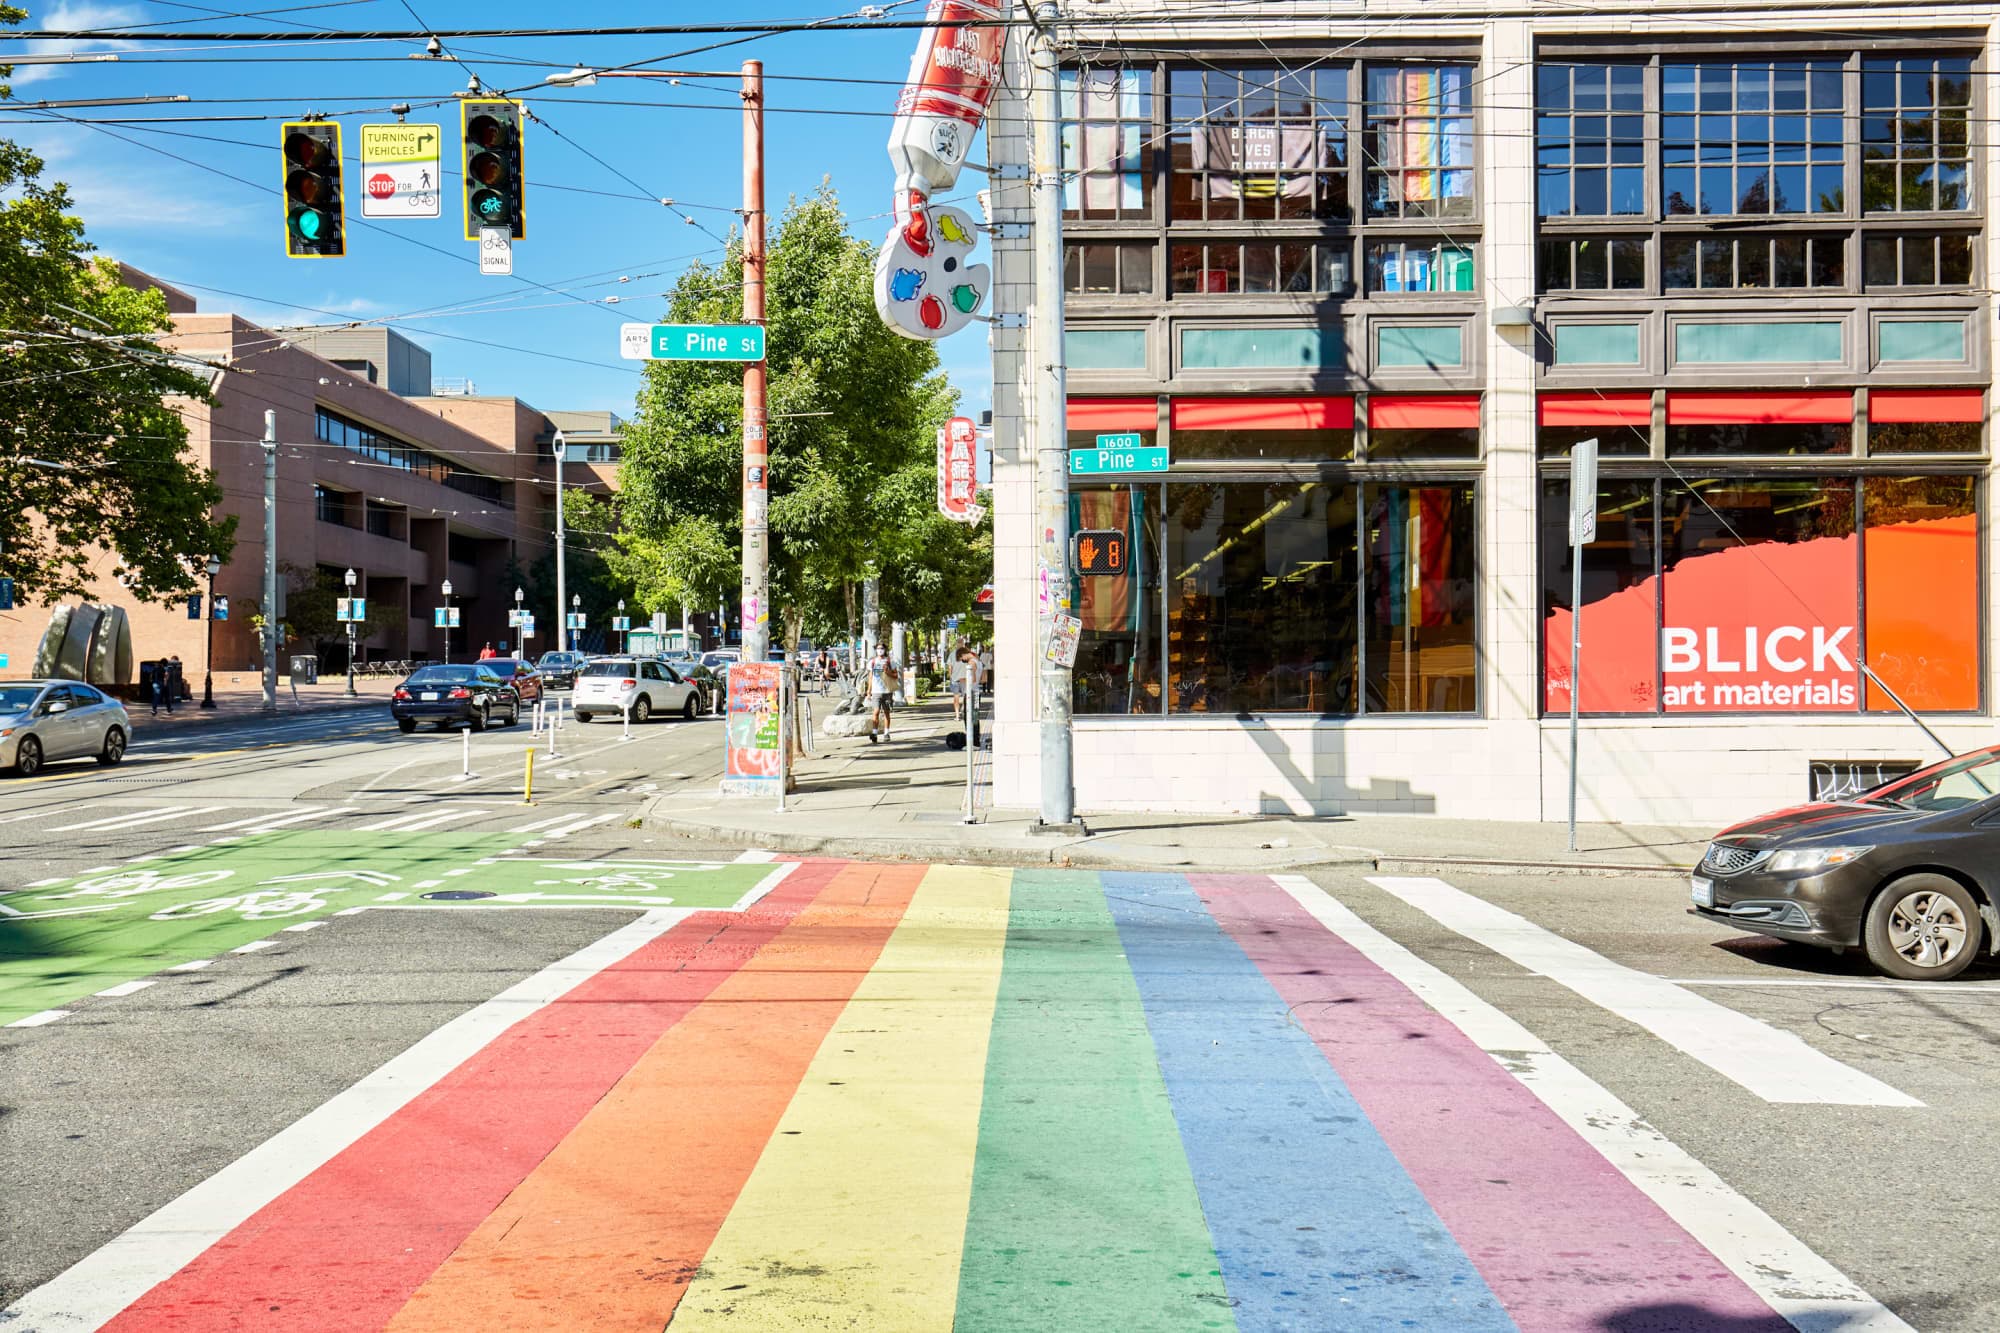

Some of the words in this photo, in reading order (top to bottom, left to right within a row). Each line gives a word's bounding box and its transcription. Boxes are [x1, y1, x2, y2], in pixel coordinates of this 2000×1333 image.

[368, 133, 415, 143] TURNING
[368, 146, 415, 156] VEHICLES
[1231, 143, 1271, 157] LVES
[369, 181, 395, 193] STOP
[397, 183, 412, 191] FOR
[483, 256, 509, 266] SIGNAL
[625, 335, 648, 343] ARTS
[659, 337, 669, 351] E
[686, 333, 728, 352] Pine
[741, 338, 756, 352] St
[1105, 437, 1132, 448] 1600
[951, 421, 970, 500] PARK
[1075, 457, 1084, 470] E
[1098, 451, 1135, 469] Pine
[1151, 457, 1164, 468] ST
[1108, 540, 1120, 568] 8
[1661, 626, 1855, 672] BLICK
[1663, 681, 1706, 705] art
[1713, 679, 1855, 705] materials
